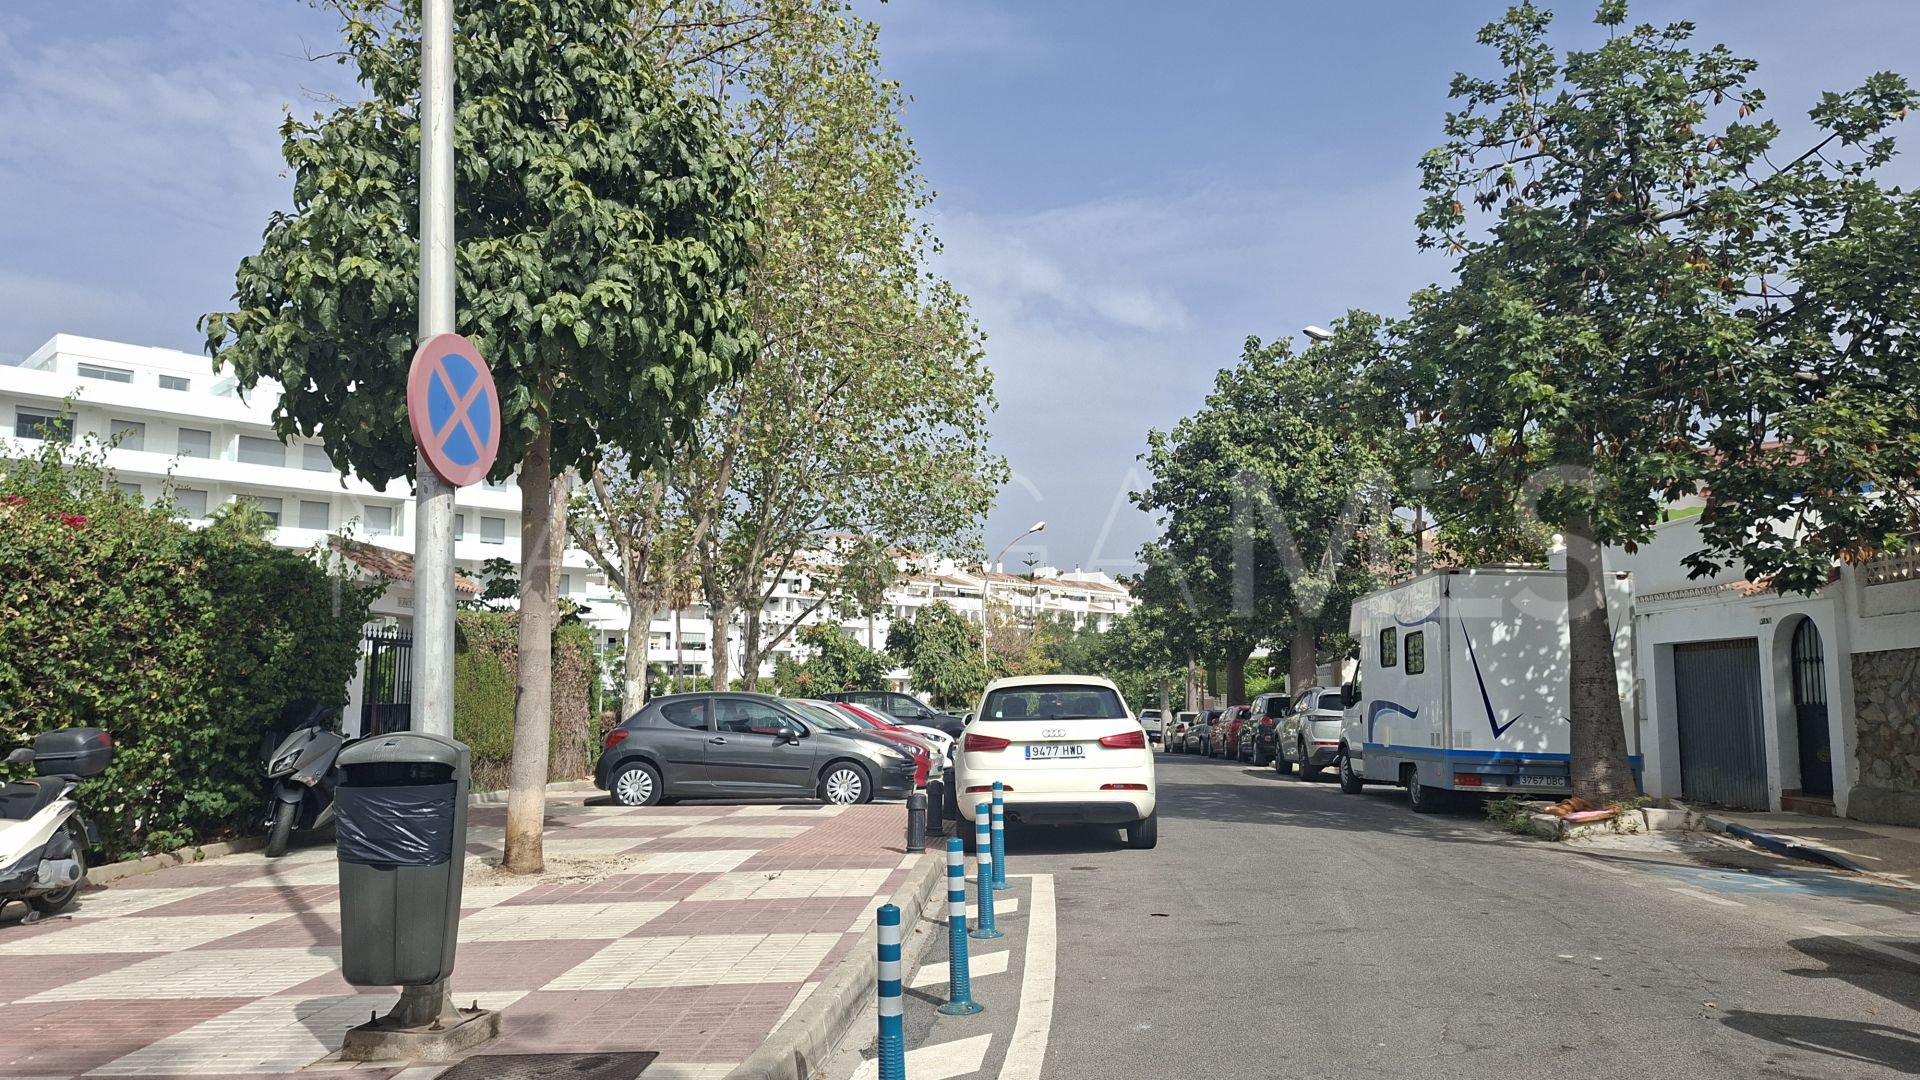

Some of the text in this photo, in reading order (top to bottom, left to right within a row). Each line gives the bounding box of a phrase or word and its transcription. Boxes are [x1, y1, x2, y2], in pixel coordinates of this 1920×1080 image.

[1032, 744, 1083, 757] 9477 HWD
[1521, 776, 1543, 785] 3767
